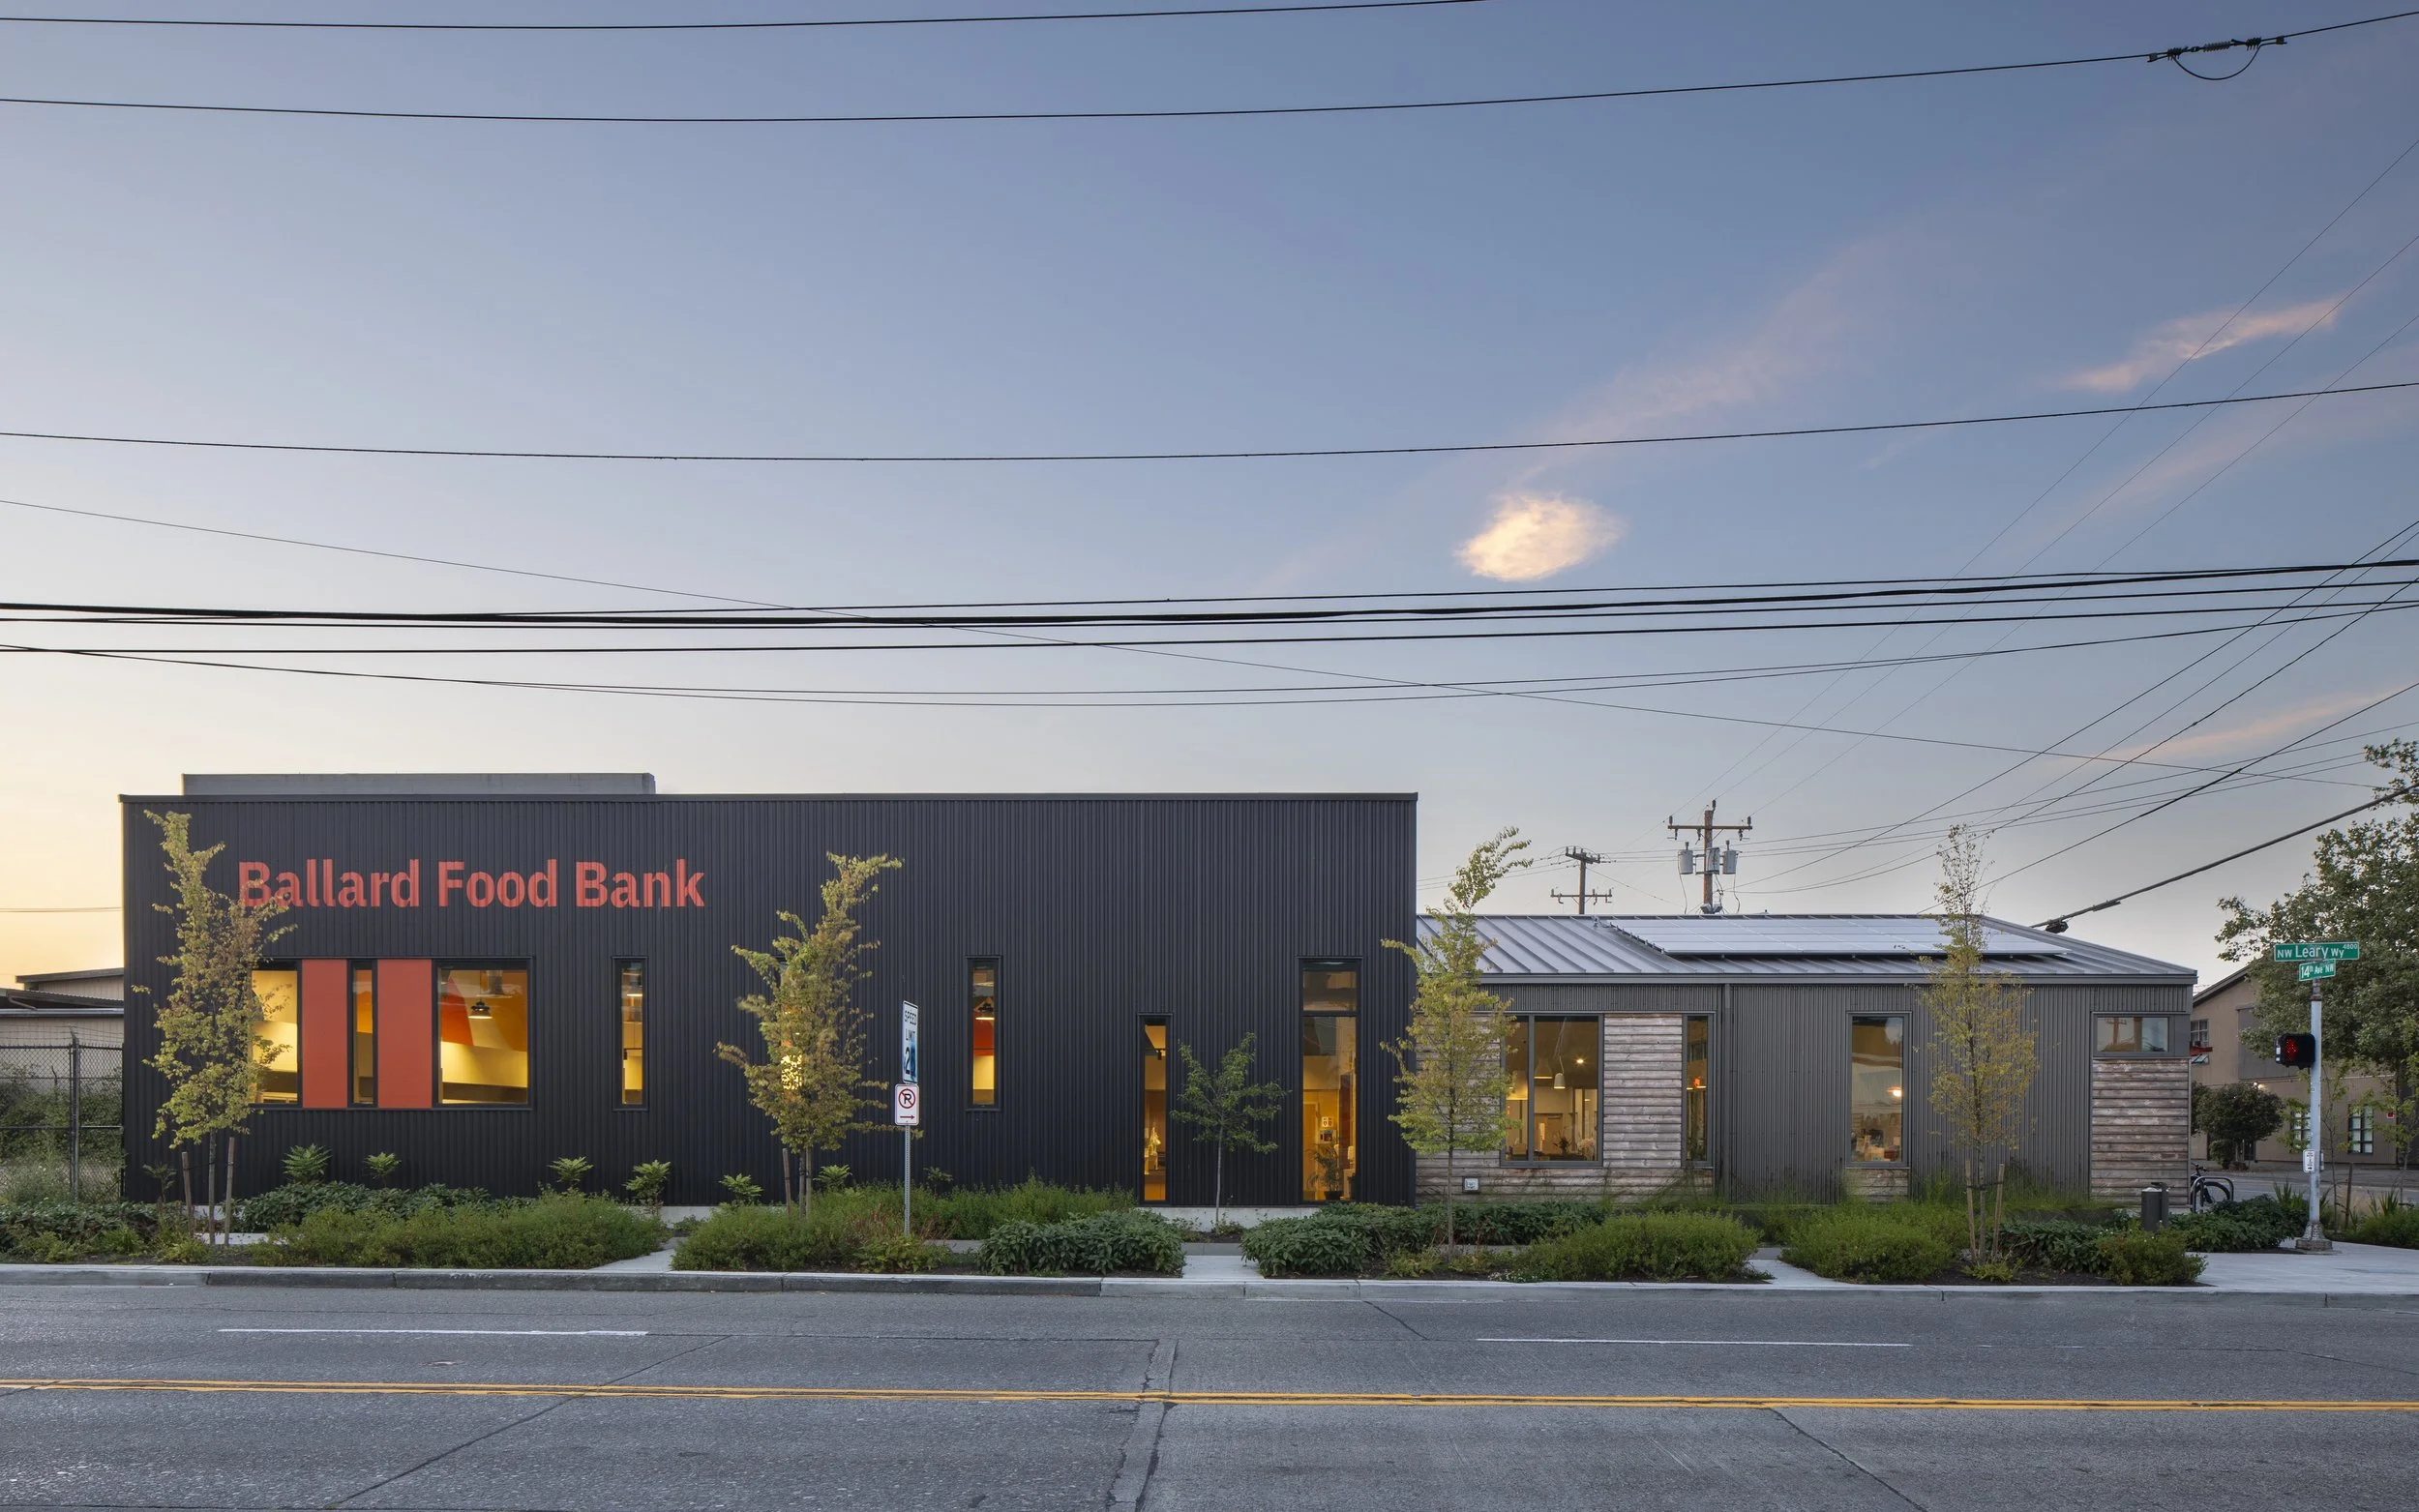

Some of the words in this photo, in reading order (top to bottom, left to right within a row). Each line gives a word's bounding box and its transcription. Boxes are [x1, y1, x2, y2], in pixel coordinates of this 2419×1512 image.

[239, 858, 420, 908] Ballard
[438, 858, 557, 908] Food
[576, 858, 705, 908] Bank
[2277, 949, 2292, 958] NW
[2295, 945, 2328, 959] Leary
[2331, 948, 2344, 958] Wy
[2325, 964, 2334, 973] NW
